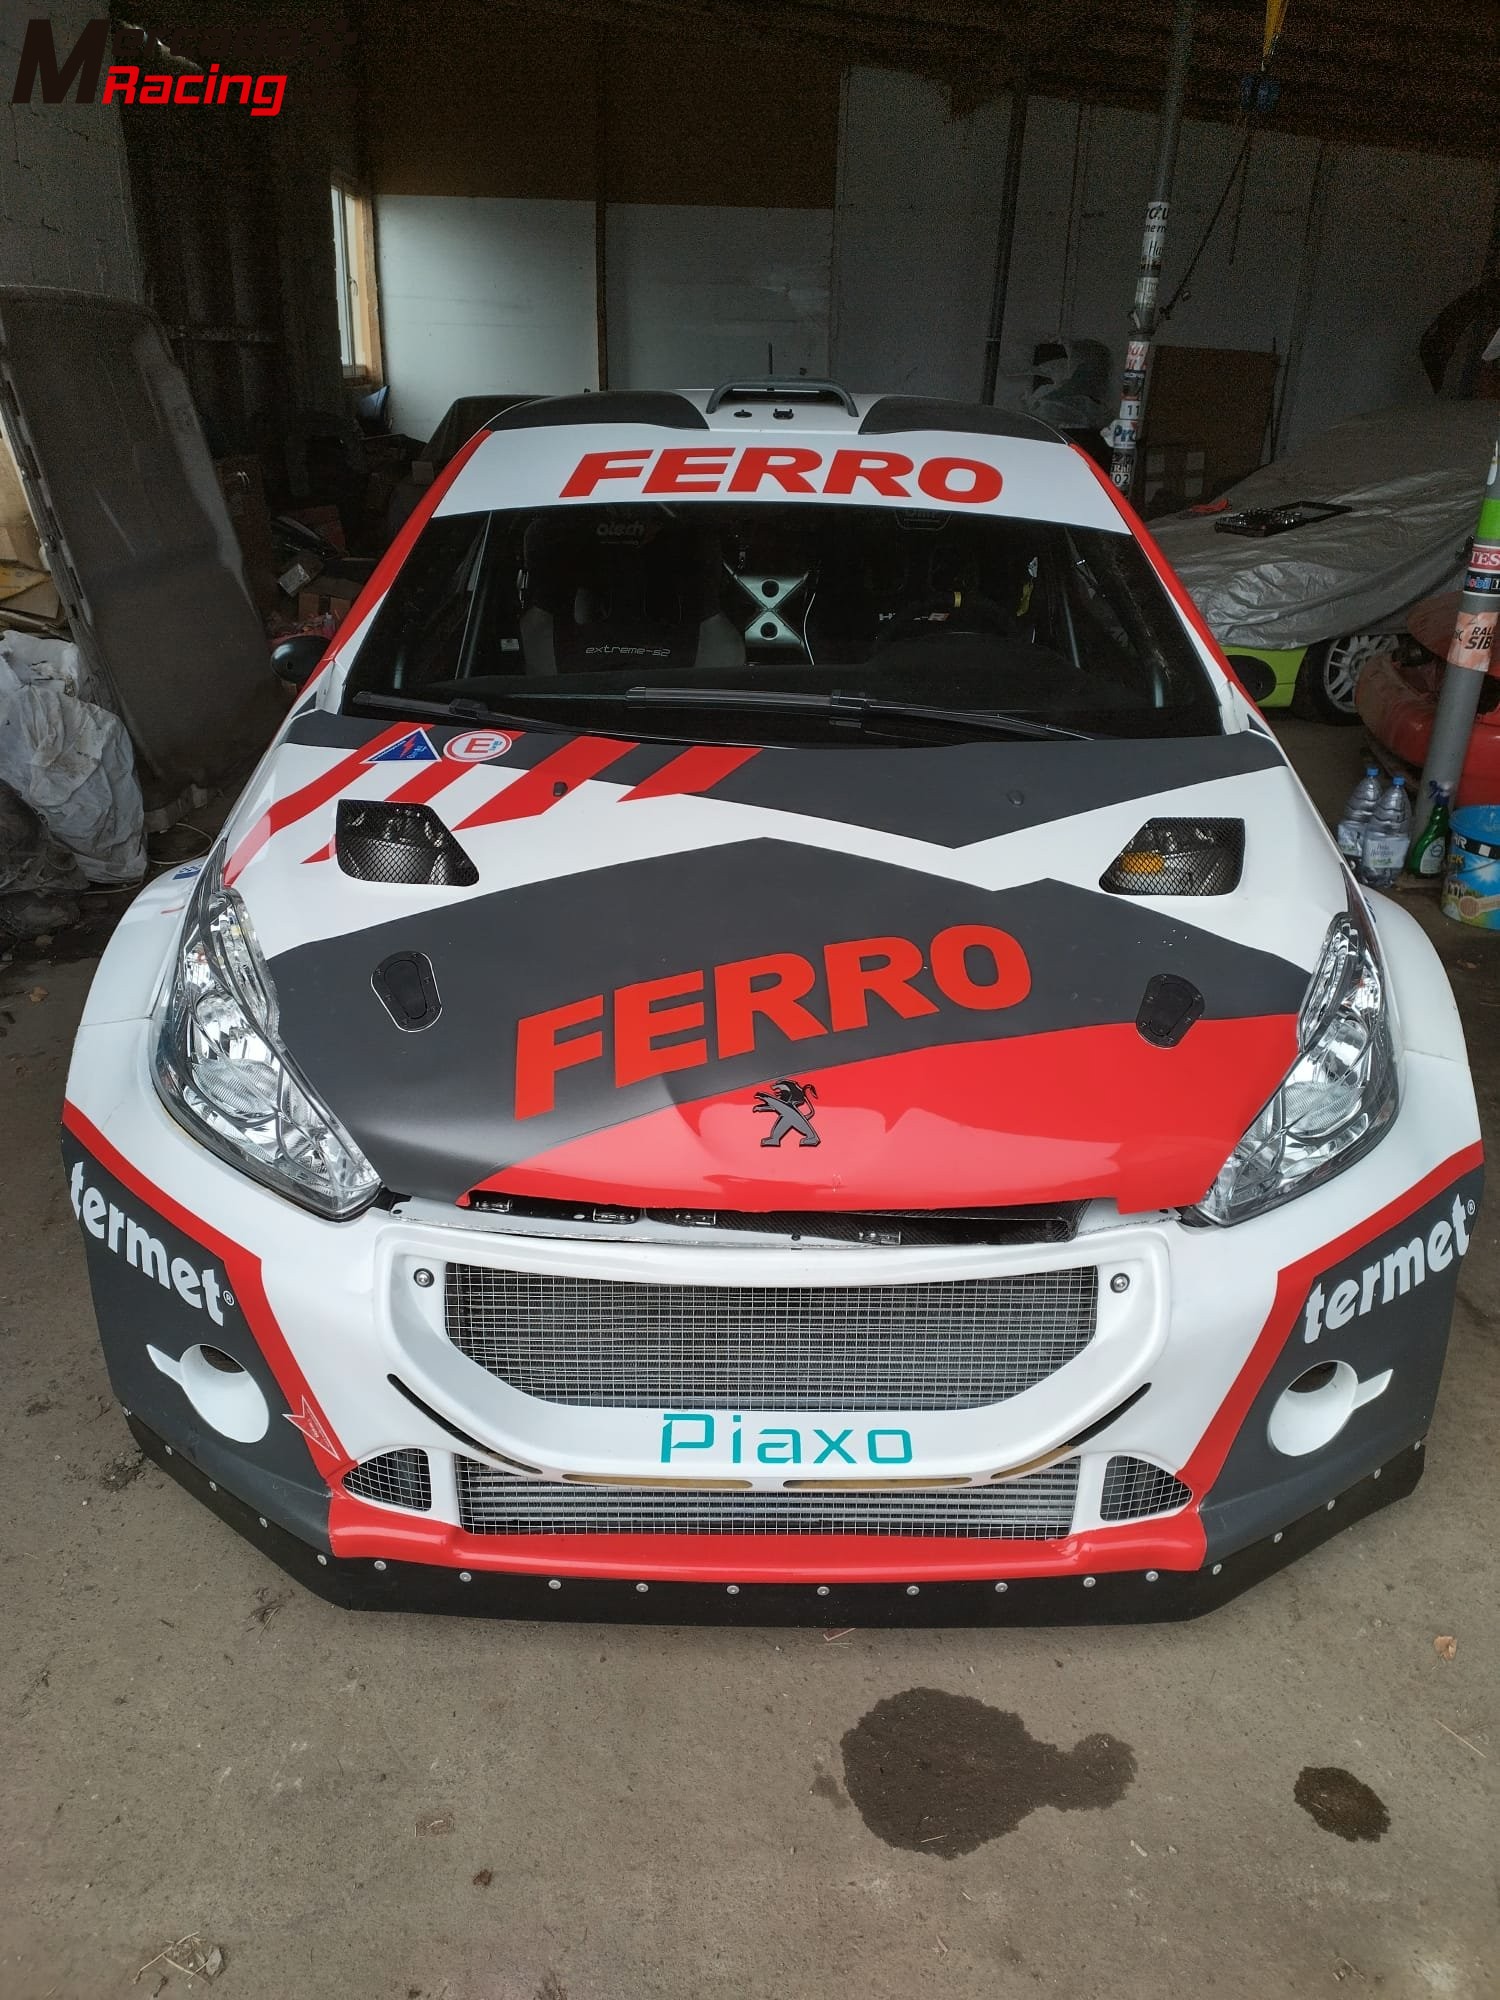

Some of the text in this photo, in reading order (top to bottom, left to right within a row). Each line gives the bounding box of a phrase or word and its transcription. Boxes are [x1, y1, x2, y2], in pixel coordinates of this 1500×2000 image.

[560, 446, 1003, 504] FERRO
[464, 737, 495, 754] E
[515, 925, 1032, 1120] FERRO
[659, 1412, 913, 1466] Piaxo
